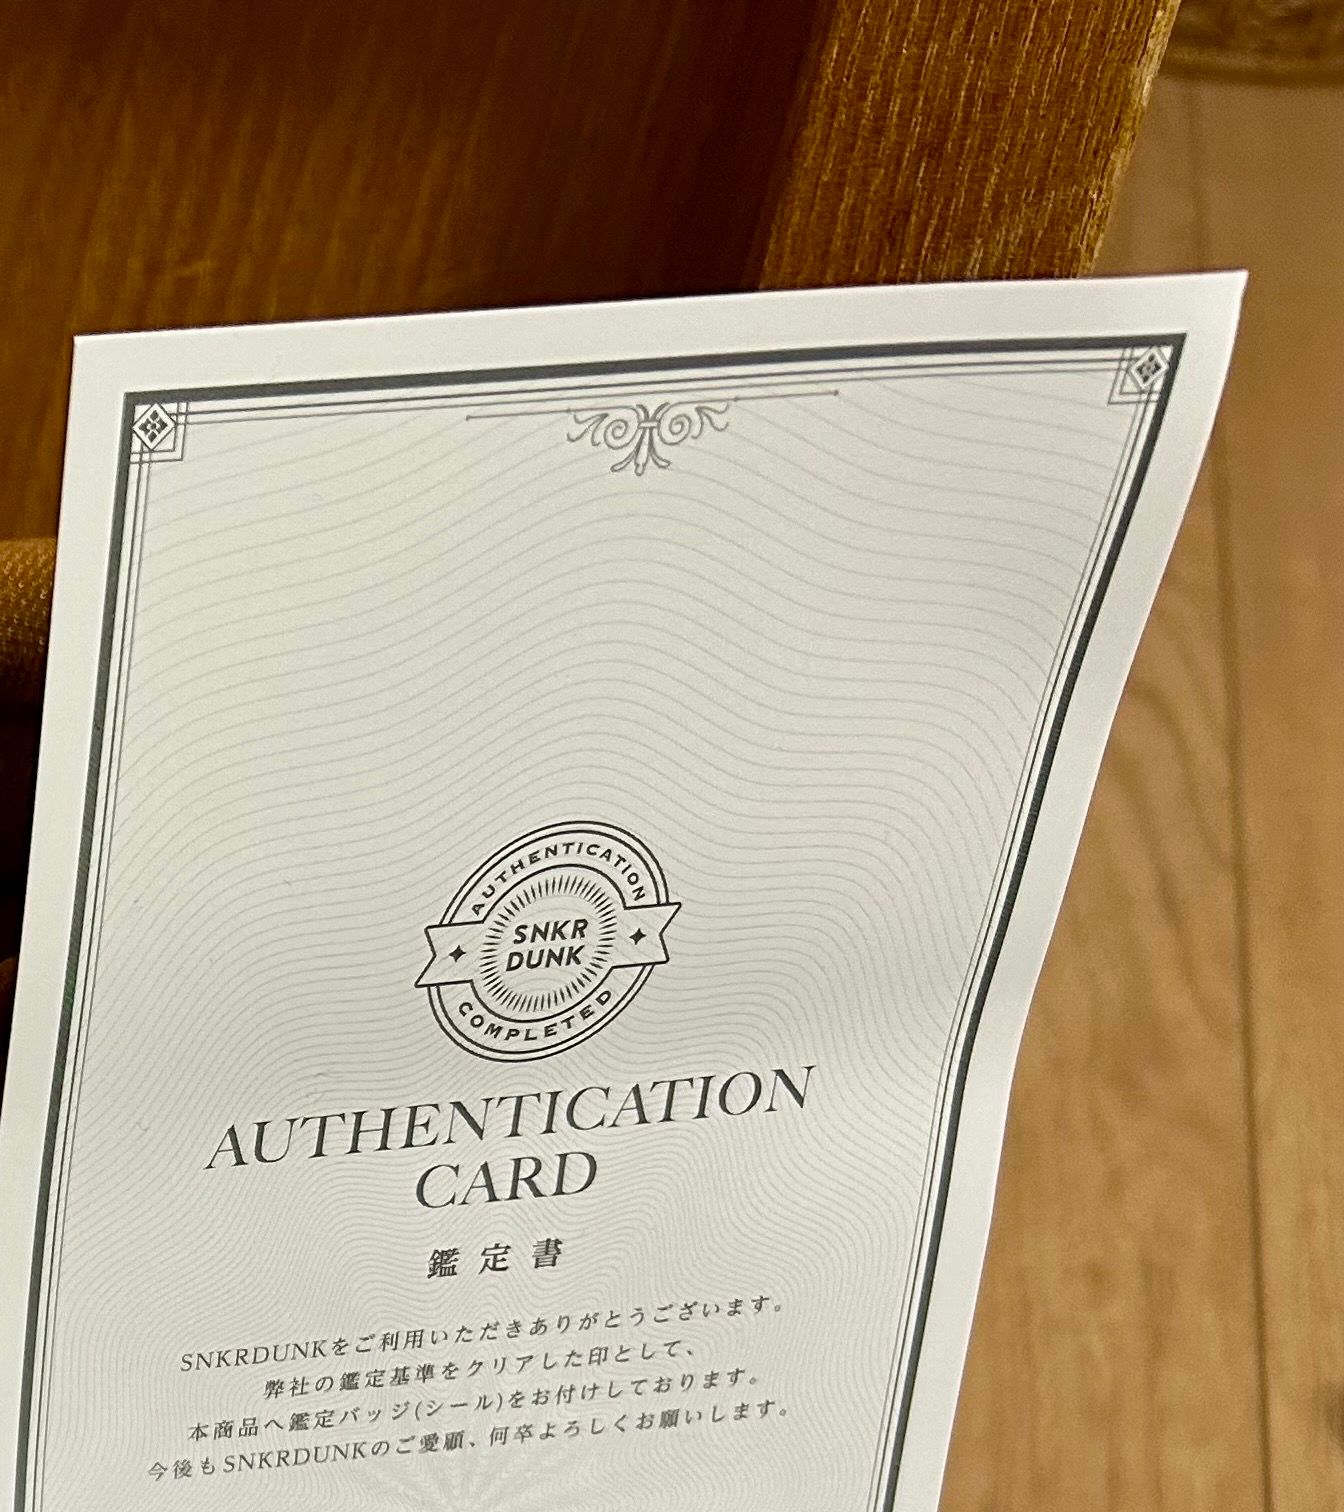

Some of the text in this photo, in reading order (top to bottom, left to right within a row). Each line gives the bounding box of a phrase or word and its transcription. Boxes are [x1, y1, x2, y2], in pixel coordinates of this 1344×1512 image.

[470, 841, 647, 917] AUTHENTICATION
[505, 945, 586, 972] DUNK
[512, 918, 590, 945] SNKR
[458, 989, 613, 1042] COMPLETED
[203, 1064, 817, 1171] AUTHENTICATION
[415, 1150, 598, 1209] CARD
[426, 1237, 565, 1279] 鑑定書
[179, 1294, 782, 1372] SNKRDUNKをご利用いただきありがとうございます。
[263, 1339, 694, 1400] 弊社の鑑定基準をクリアした印として、
